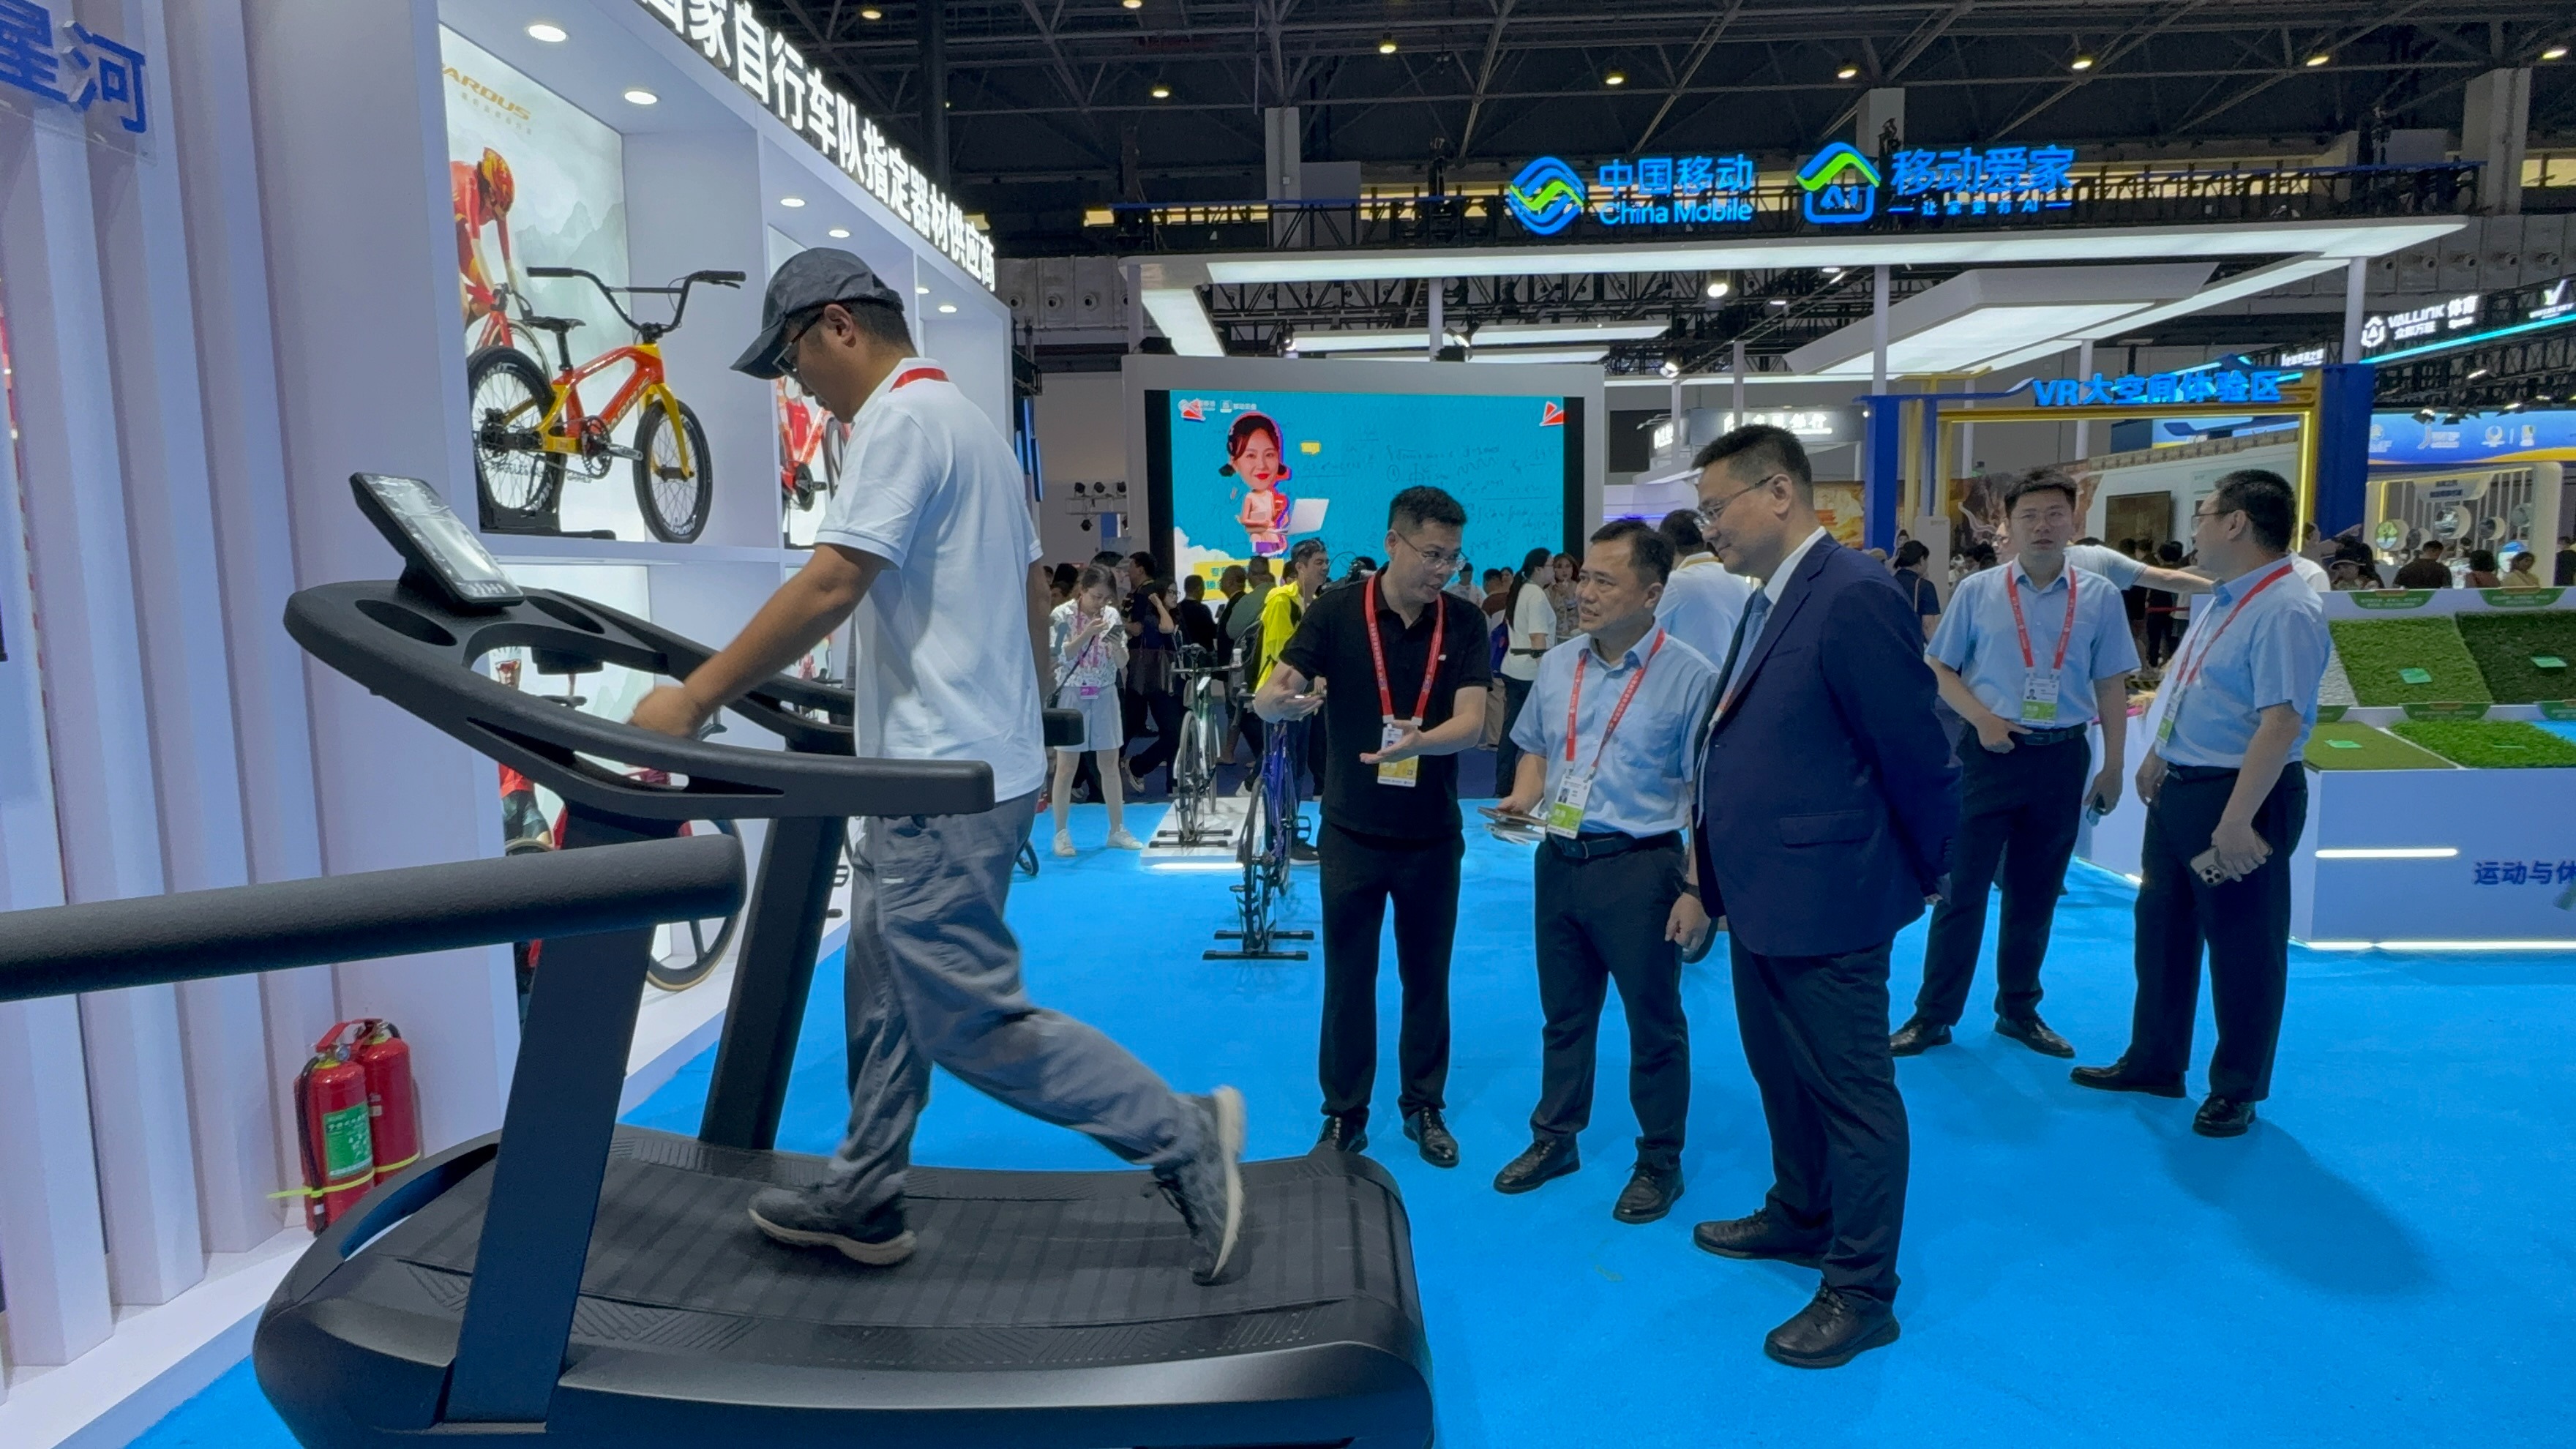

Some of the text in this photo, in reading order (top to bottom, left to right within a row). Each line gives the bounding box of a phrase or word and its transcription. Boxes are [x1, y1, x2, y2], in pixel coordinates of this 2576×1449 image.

[442, 67, 532, 121] ARDUS
[1599, 153, 1753, 197] 中国移动
[1890, 145, 2075, 196] 移动爱家
[1598, 197, 1753, 225] China Mobile
[2032, 369, 2282, 406] VR大空间体验区
